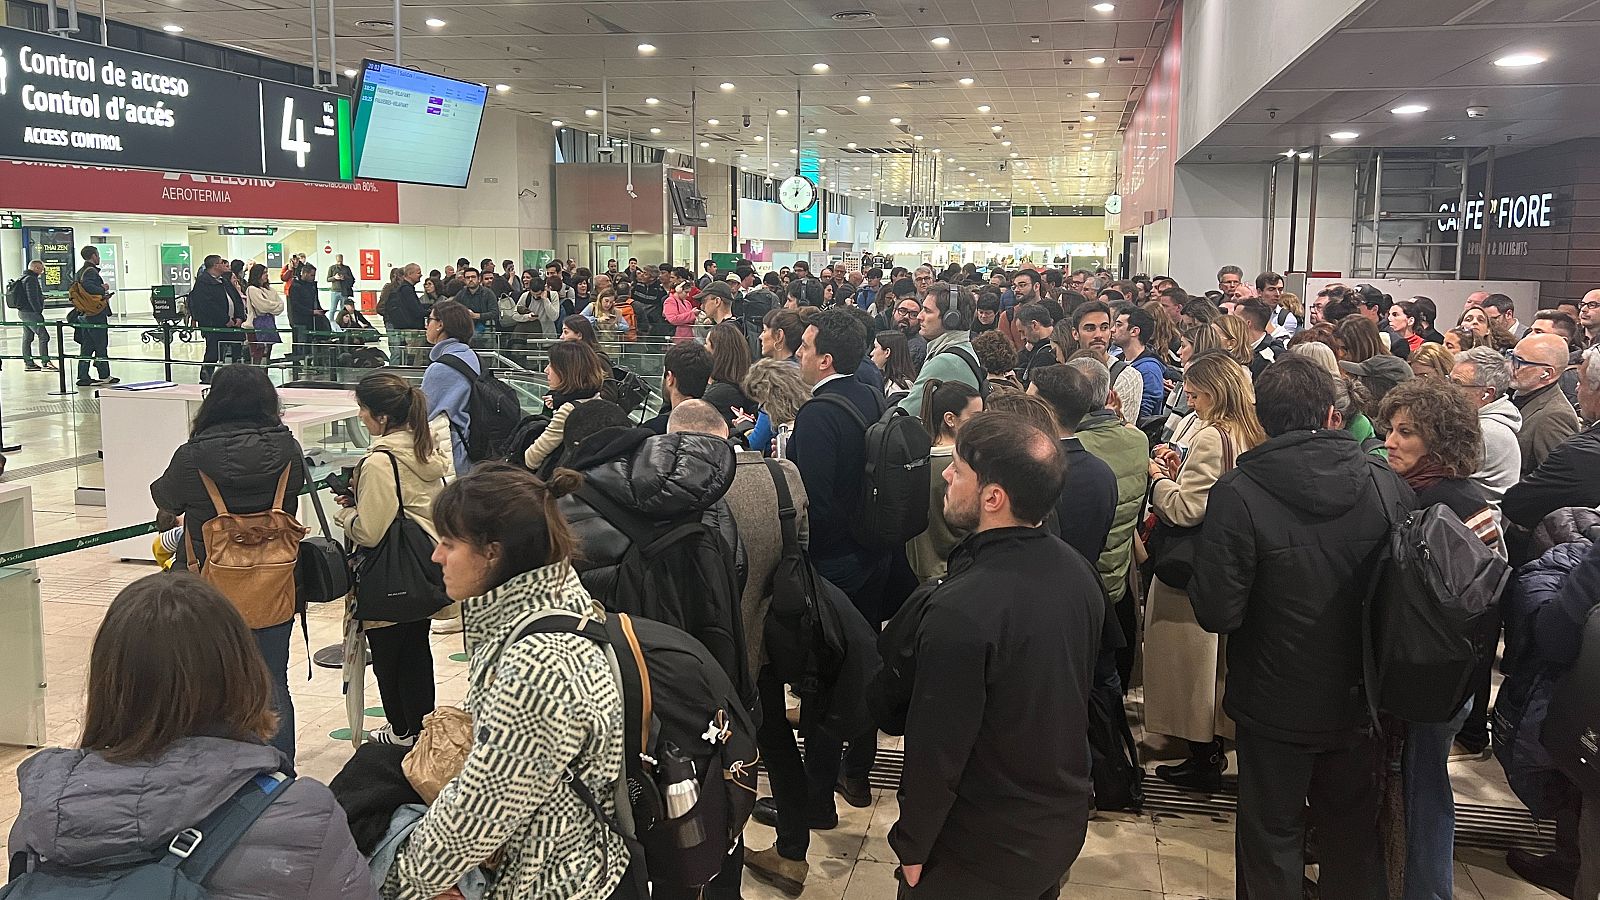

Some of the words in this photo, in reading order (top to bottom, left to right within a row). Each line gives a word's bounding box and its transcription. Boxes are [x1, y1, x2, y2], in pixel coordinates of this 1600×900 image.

[20, 46, 95, 82] Control
[101, 61, 126, 87] de
[131, 70, 189, 97] acceso
[22, 84, 100, 118] Control
[106, 96, 175, 127] d'accés
[24, 126, 69, 146] ACCESS
[70, 131, 123, 151] CONTROL
[281, 96, 311, 167] 4
[162, 186, 231, 203] AEROTERMIA
[1498, 193, 1552, 229] FIORE
